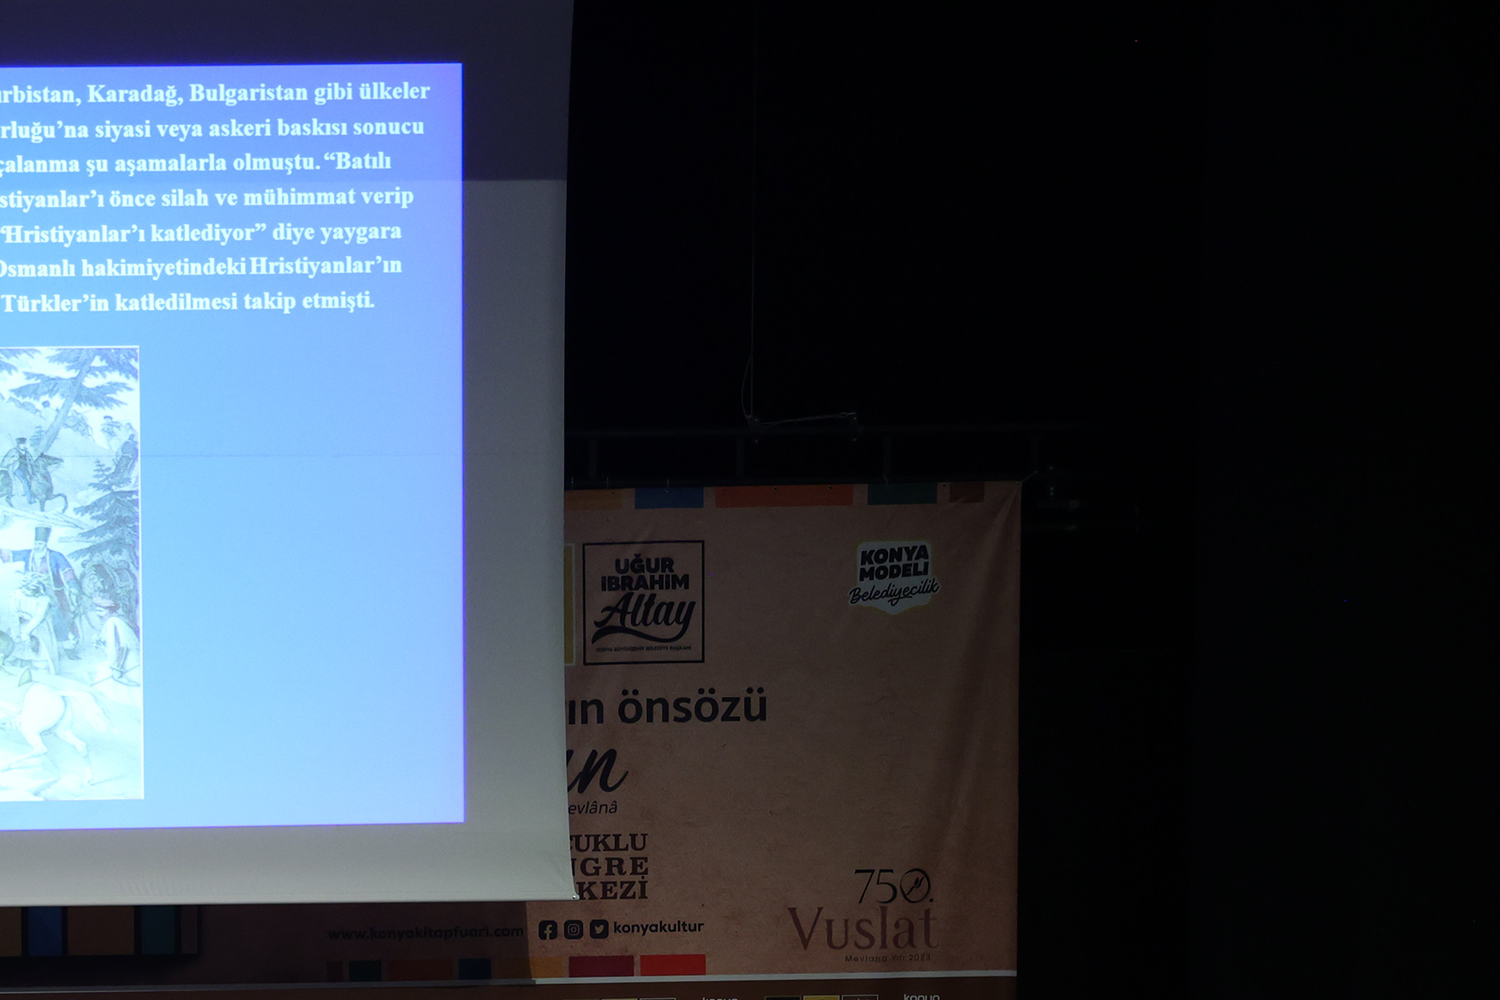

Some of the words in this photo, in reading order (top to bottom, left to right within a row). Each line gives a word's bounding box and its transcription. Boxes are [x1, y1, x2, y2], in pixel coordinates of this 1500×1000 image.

[86, 84, 184, 109] Karadağ,
[188, 82, 309, 107] Bulgaristan
[314, 81, 354, 106] gibi
[358, 80, 431, 100] ülkeler
[94, 119, 152, 143] siyasi
[156, 123, 204, 143] veya
[208, 118, 272, 138] askeri
[276, 117, 348, 137] baskısı
[353, 121, 425, 136] sonucu
[85, 158, 109, 178] şu
[114, 152, 228, 176] aşamalarla
[232, 151, 321, 176] olmuştu.
[323, 151, 392, 170] “Batılı
[108, 189, 157, 208] önce
[161, 188, 210, 207] silah
[214, 192, 239, 207] ve
[243, 187, 357, 206] mühimmat
[360, 187, 414, 210] verip
[150, 222, 267, 247] katlediyor”
[272, 222, 316, 246] diye
[319, 226, 402, 245] yaygara
[81, 256, 247, 281] hakimiyetindeki
[249, 255, 403, 279] Hristiyanlar’ın
[0, 292, 110, 313] Türkler’in
[114, 291, 239, 312] katledilmesi
[243, 290, 297, 315] takip
[302, 290, 376, 314] etmişti.
[615, 553, 674, 574] UĞUR
[861, 545, 929, 565] KONYA
[849, 578, 940, 606] Belediyecilik
[591, 592, 696, 644] Altay
[618, 687, 767, 724] önsözü
[613, 920, 704, 936] konyakultur
[787, 905, 939, 950] Vuslat
[908, 953, 931, 961] 2023
